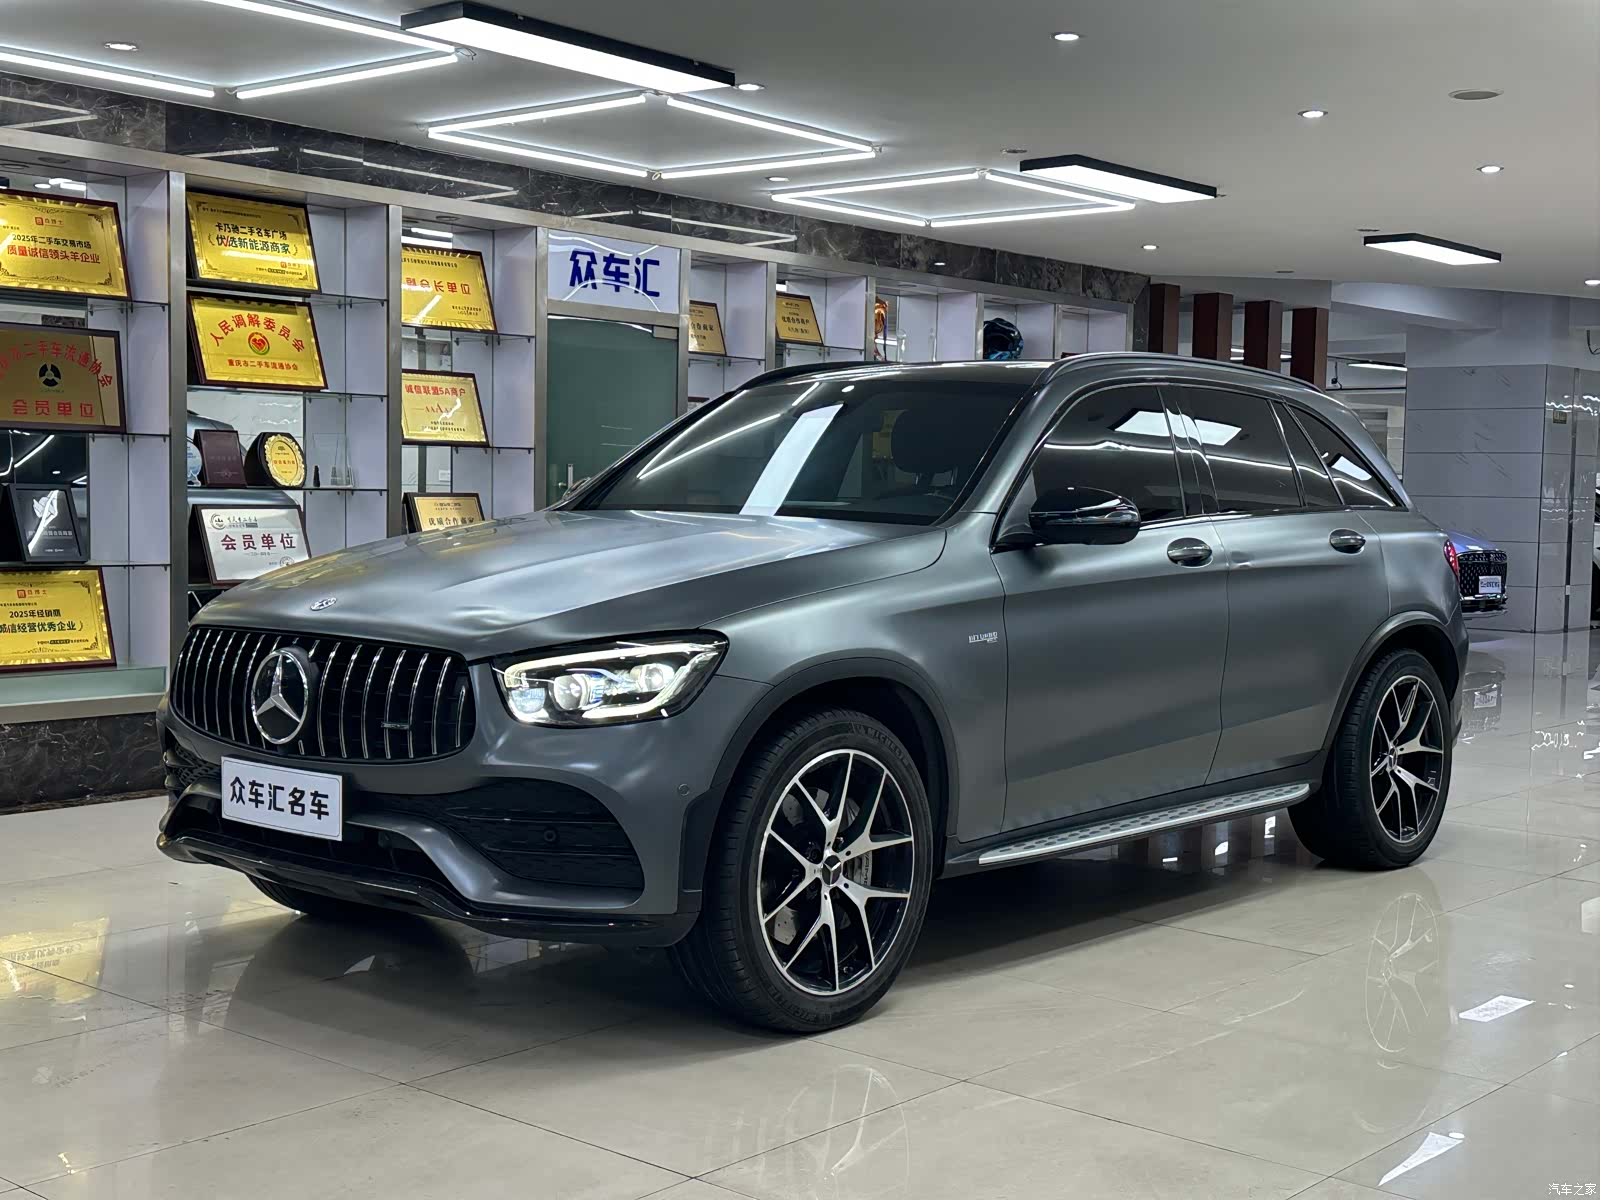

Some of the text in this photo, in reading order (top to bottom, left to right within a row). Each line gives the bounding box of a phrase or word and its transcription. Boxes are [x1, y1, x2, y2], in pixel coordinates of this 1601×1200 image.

[12, 234, 92, 249] 2025年二手车交易市场
[8, 245, 101, 264] 质量诚信领头羊企业
[569, 250, 660, 297] 众车汇
[210, 313, 305, 352] 人民调解委员会
[227, 358, 299, 371] 重庆市二手车流通协会
[405, 384, 466, 397] 诚信联盟5A商户
[12, 399, 95, 417] 会员单位
[221, 533, 296, 551] 会员单位
[9, 609, 62, 618] 2025年经销商
[230, 776, 330, 821] 众车汇名车
